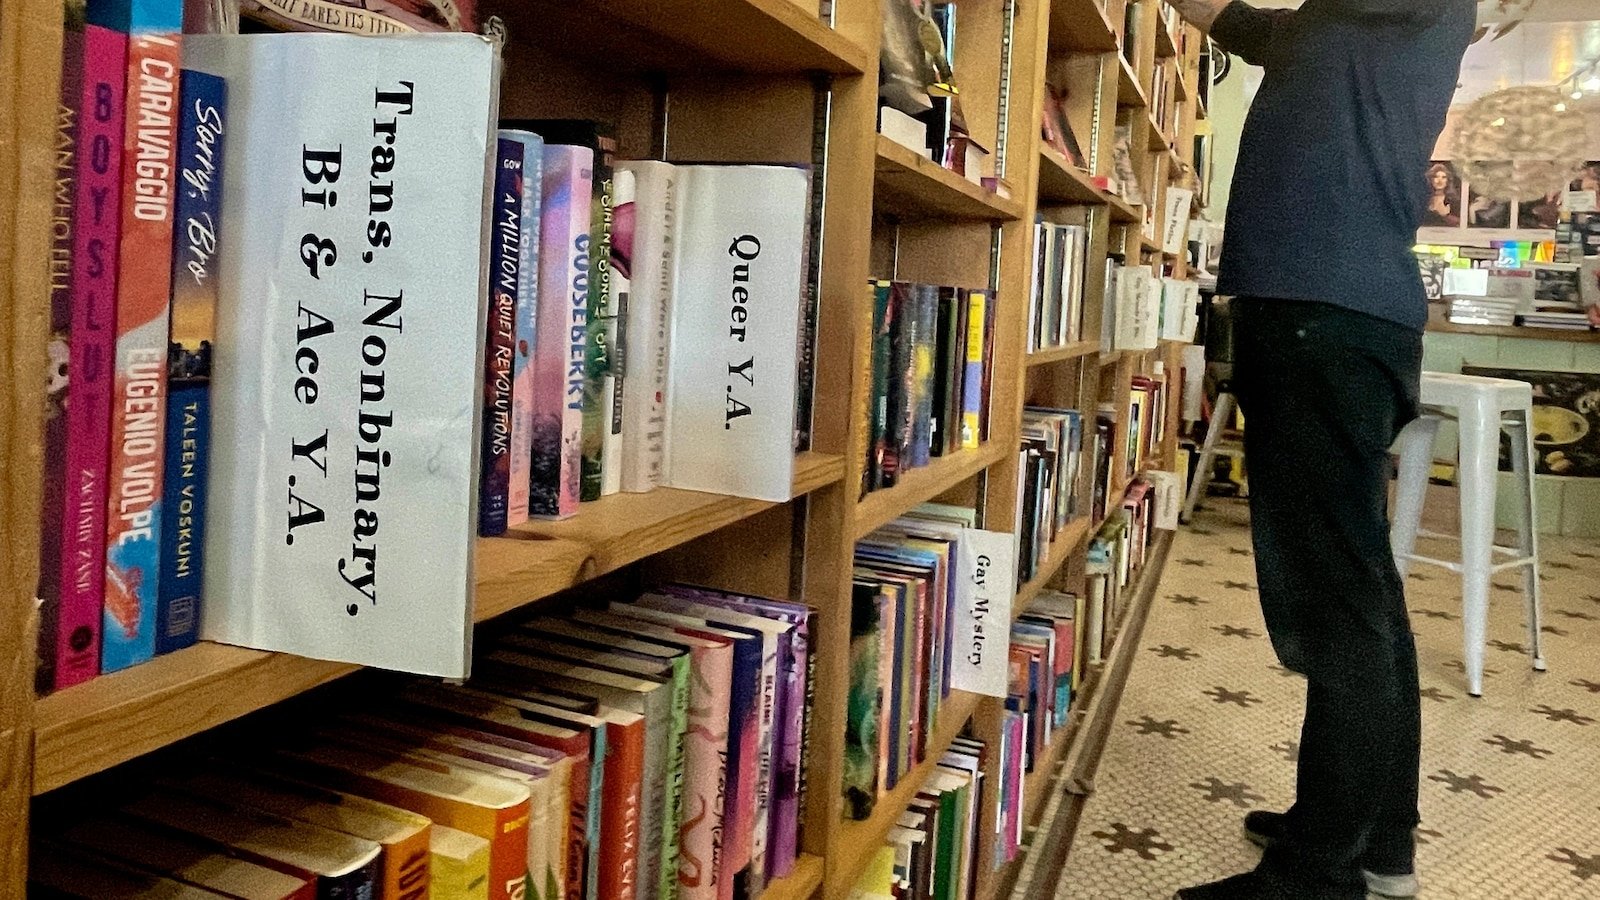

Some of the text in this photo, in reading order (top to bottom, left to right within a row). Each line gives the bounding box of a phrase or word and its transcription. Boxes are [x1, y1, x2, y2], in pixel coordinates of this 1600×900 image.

[302, 2, 341, 25] BARES
[345, 12, 365, 30] ITS
[54, 104, 77, 170] MAN
[134, 57, 174, 222] CARAVAGGIO
[301, 143, 343, 210] Bi
[503, 159, 521, 169] GOW
[52, 176, 73, 240] WHO
[182, 97, 223, 286] Sorry, Bro
[299, 233, 338, 280] &
[293, 300, 336, 405] Ace
[337, 80, 415, 617] Trans, Nonbinary,
[491, 192, 520, 457] A MILLION QUIET REVOLUTIONS
[567, 233, 590, 412] GOOSEBERRY
[725, 233, 762, 431] Queer Y.A.
[118, 347, 161, 547] EUGENIO VOLPE
[181, 402, 199, 478] TALEEN
[175, 484, 195, 579] VOSKUNI
[967, 554, 991, 669] Gay Mystery
